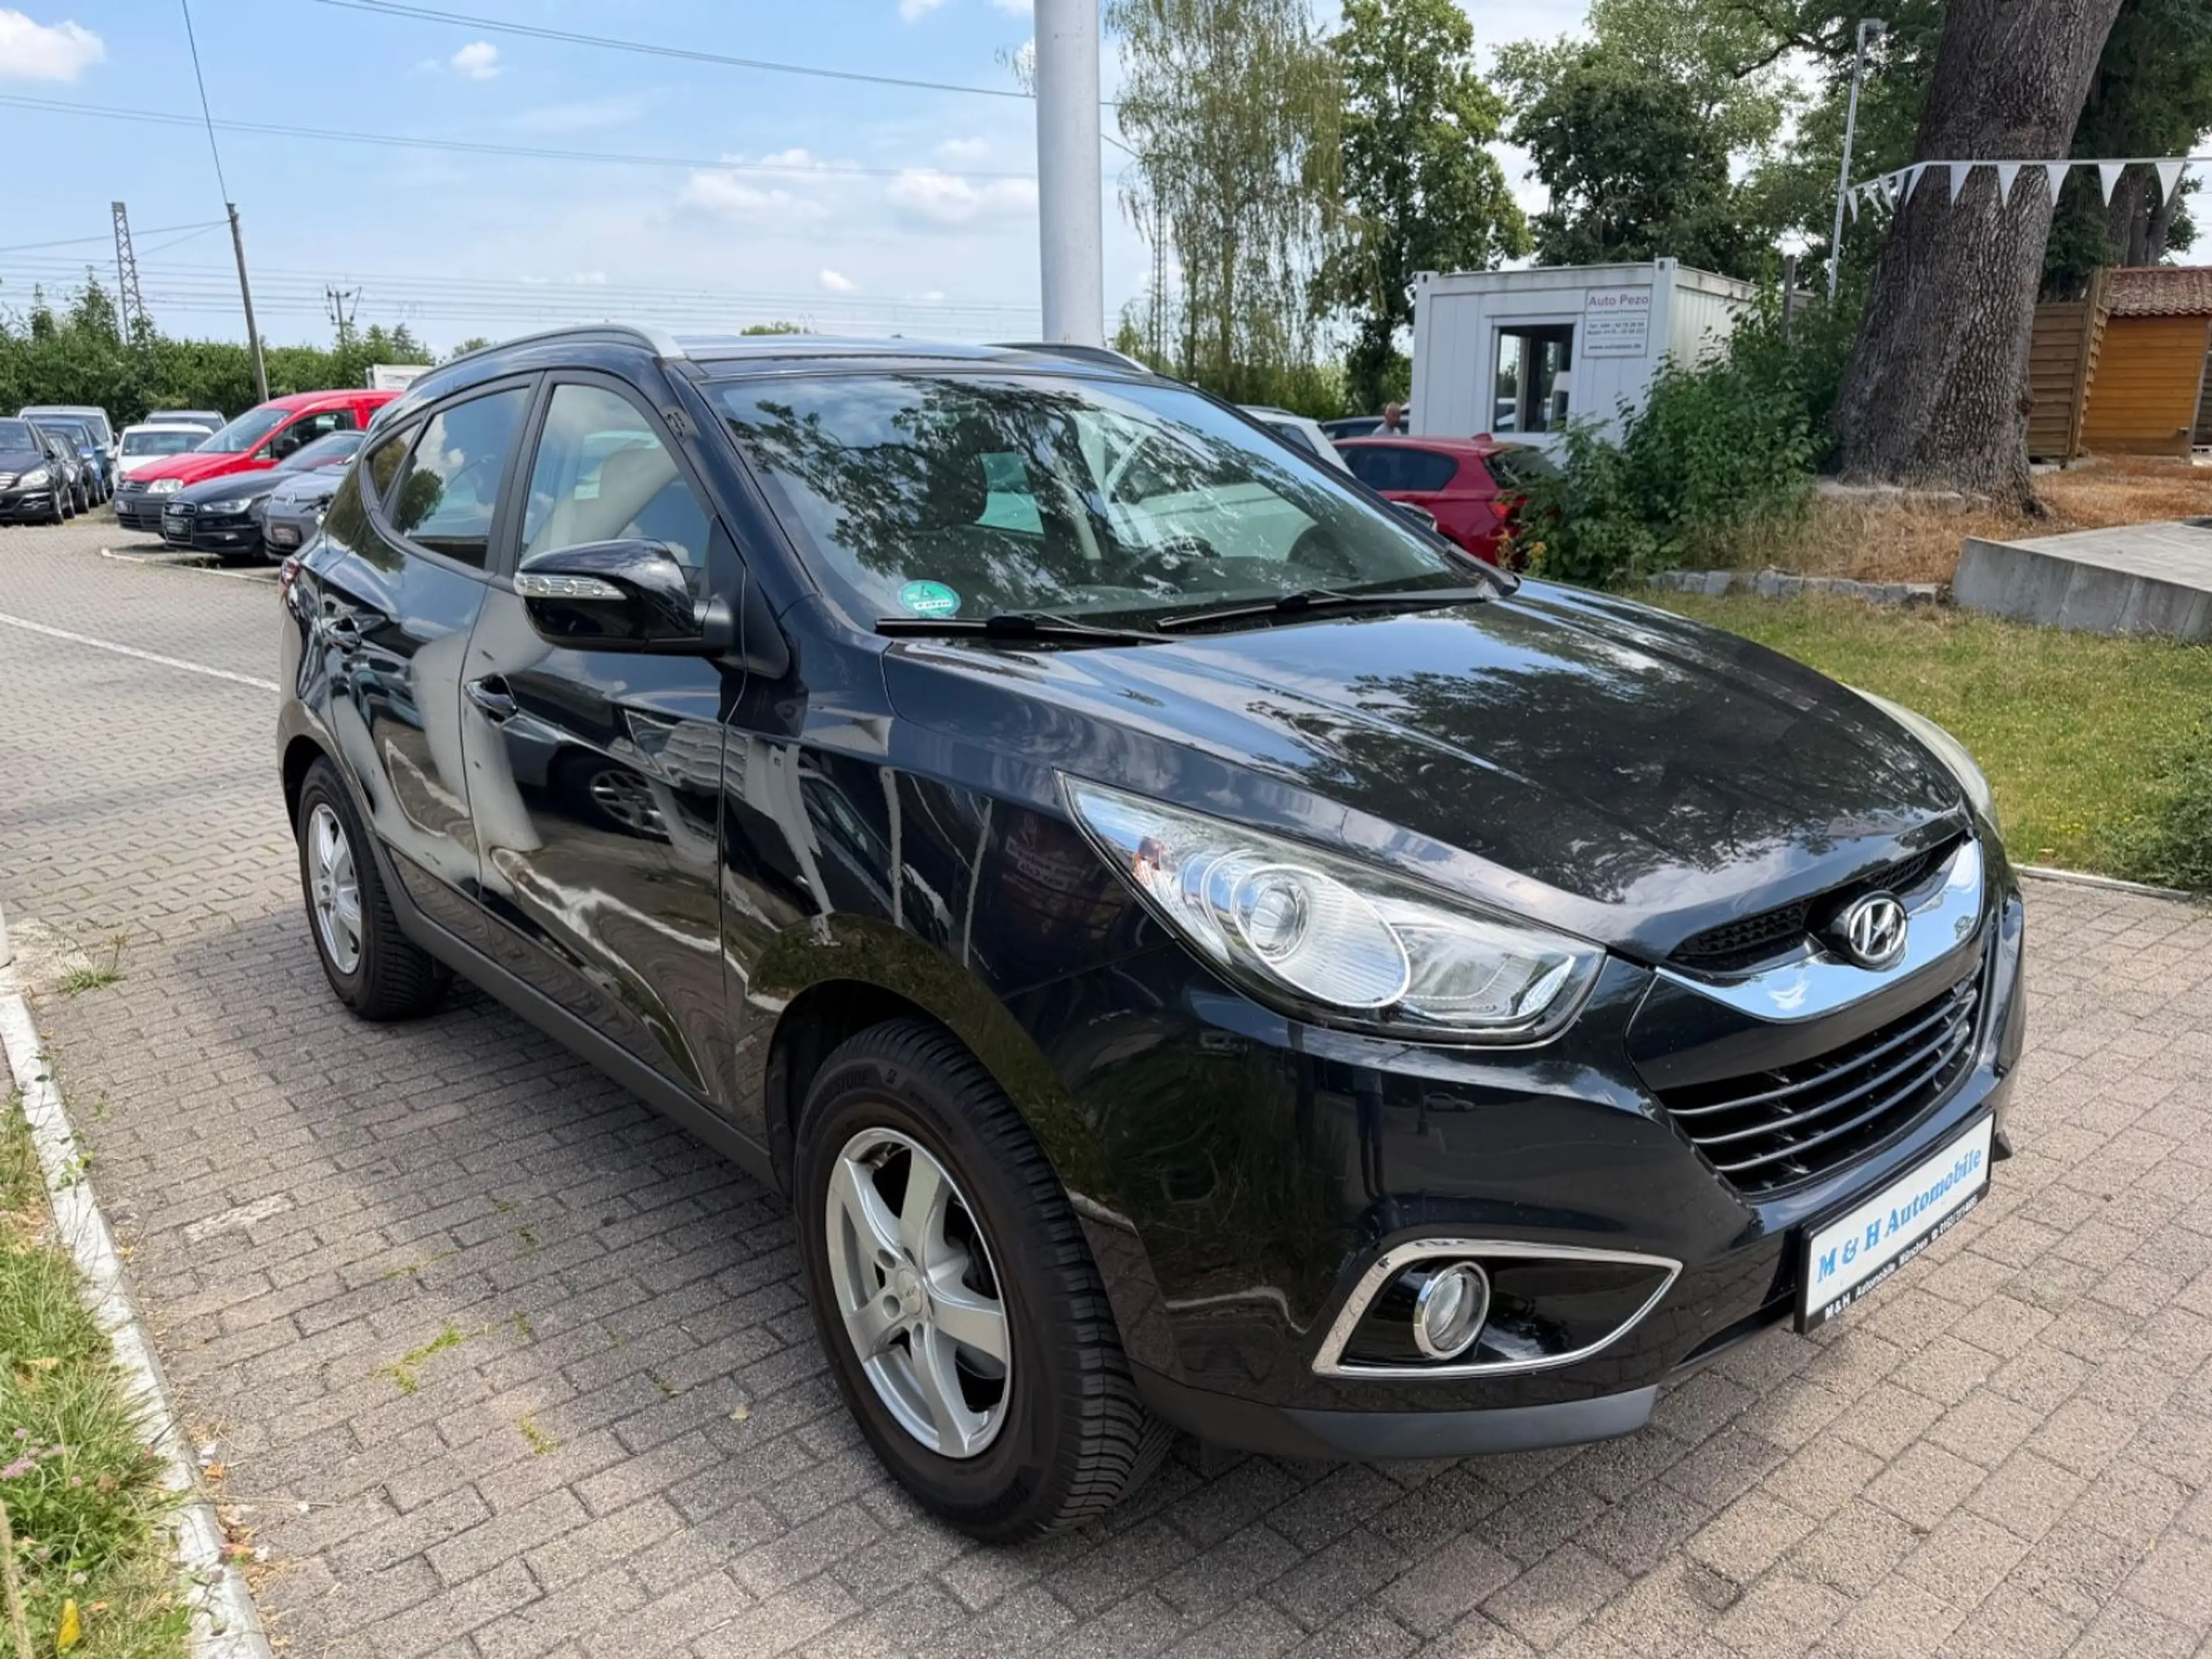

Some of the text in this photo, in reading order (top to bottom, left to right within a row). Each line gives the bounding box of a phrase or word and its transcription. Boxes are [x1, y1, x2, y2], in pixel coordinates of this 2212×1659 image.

[1589, 294, 1648, 306] Auto Pezo
[1817, 1247, 1837, 1283] M
[1842, 1237, 1859, 1264] &
[1863, 1218, 1882, 1251] H
[1885, 1149, 1982, 1237] Automobile
